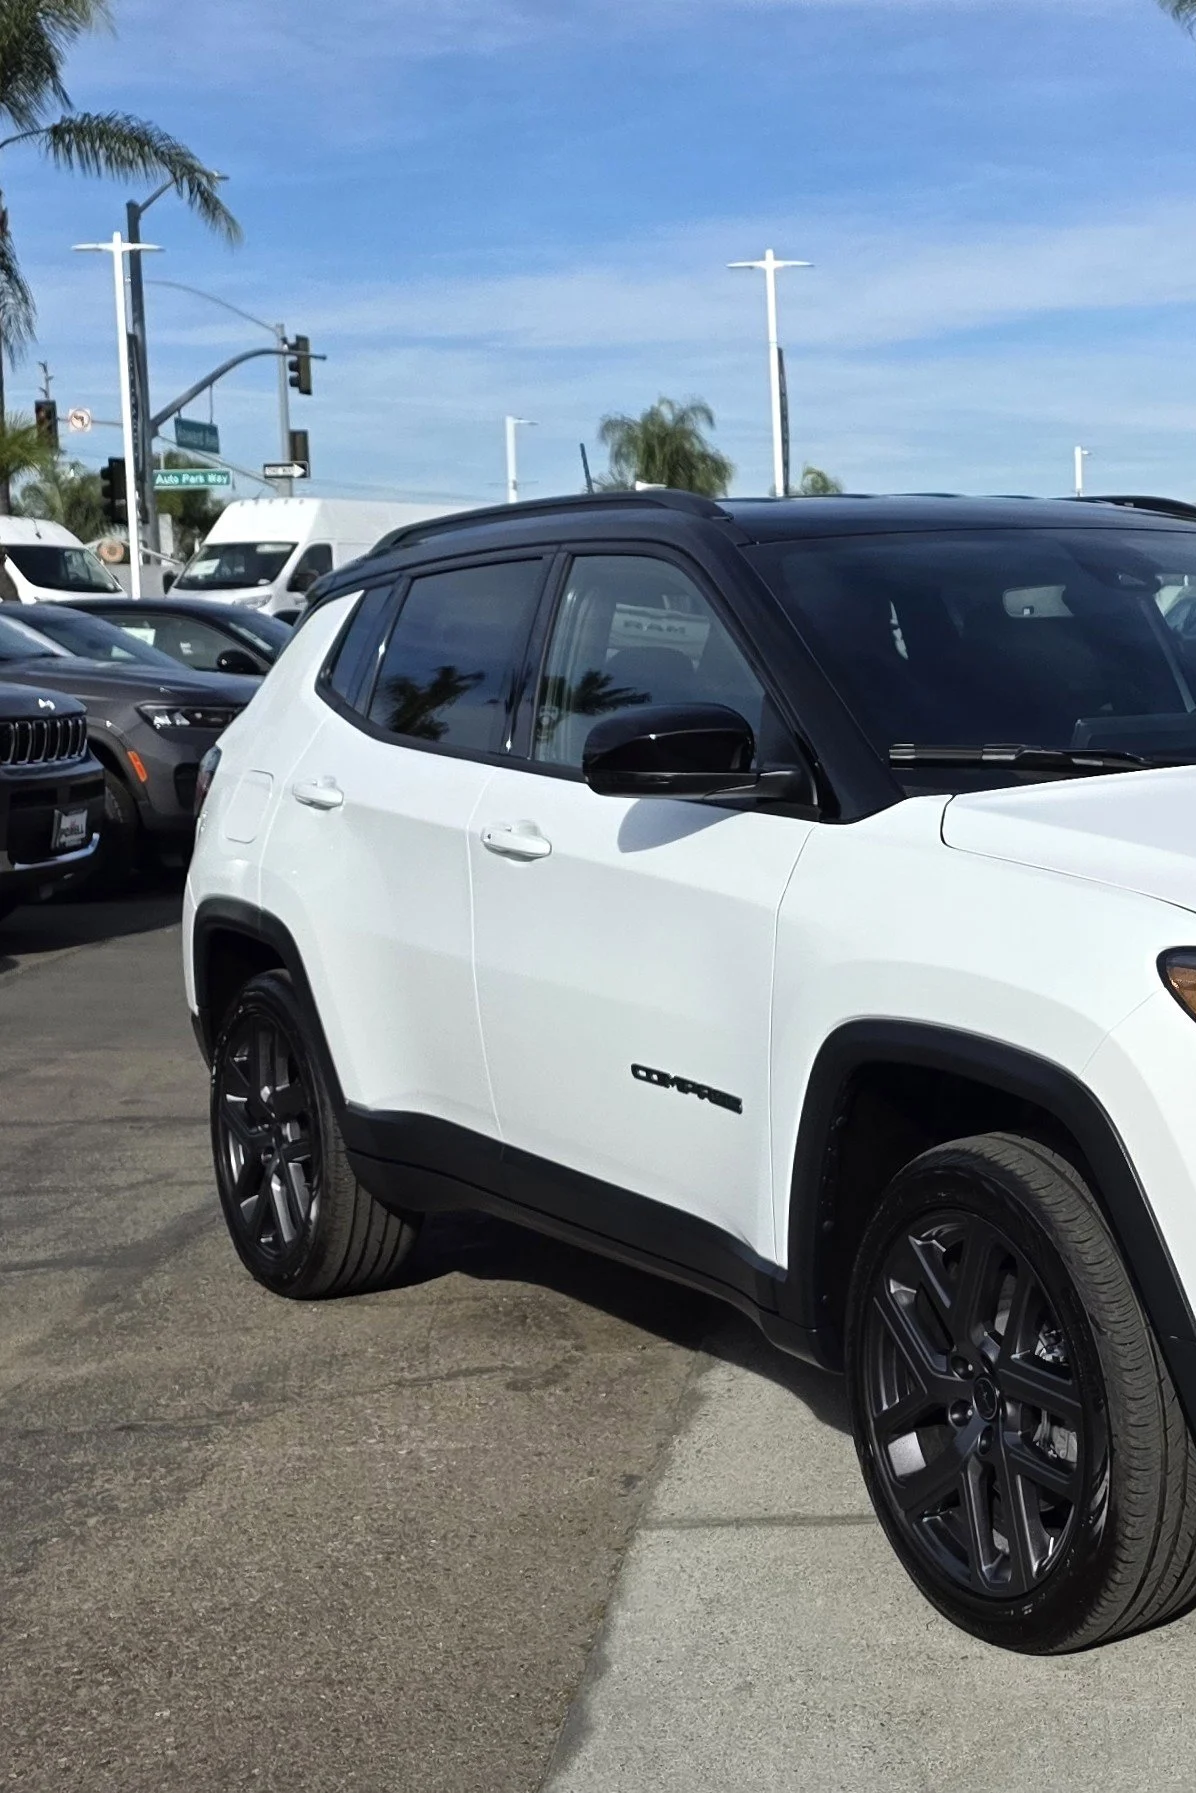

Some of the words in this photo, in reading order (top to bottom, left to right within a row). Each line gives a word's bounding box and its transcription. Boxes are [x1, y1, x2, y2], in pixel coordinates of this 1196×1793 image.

[155, 473, 180, 485] Auto
[182, 473, 205, 484] Park
[207, 473, 228, 485] Way
[630, 1063, 743, 1115] COMPASS
